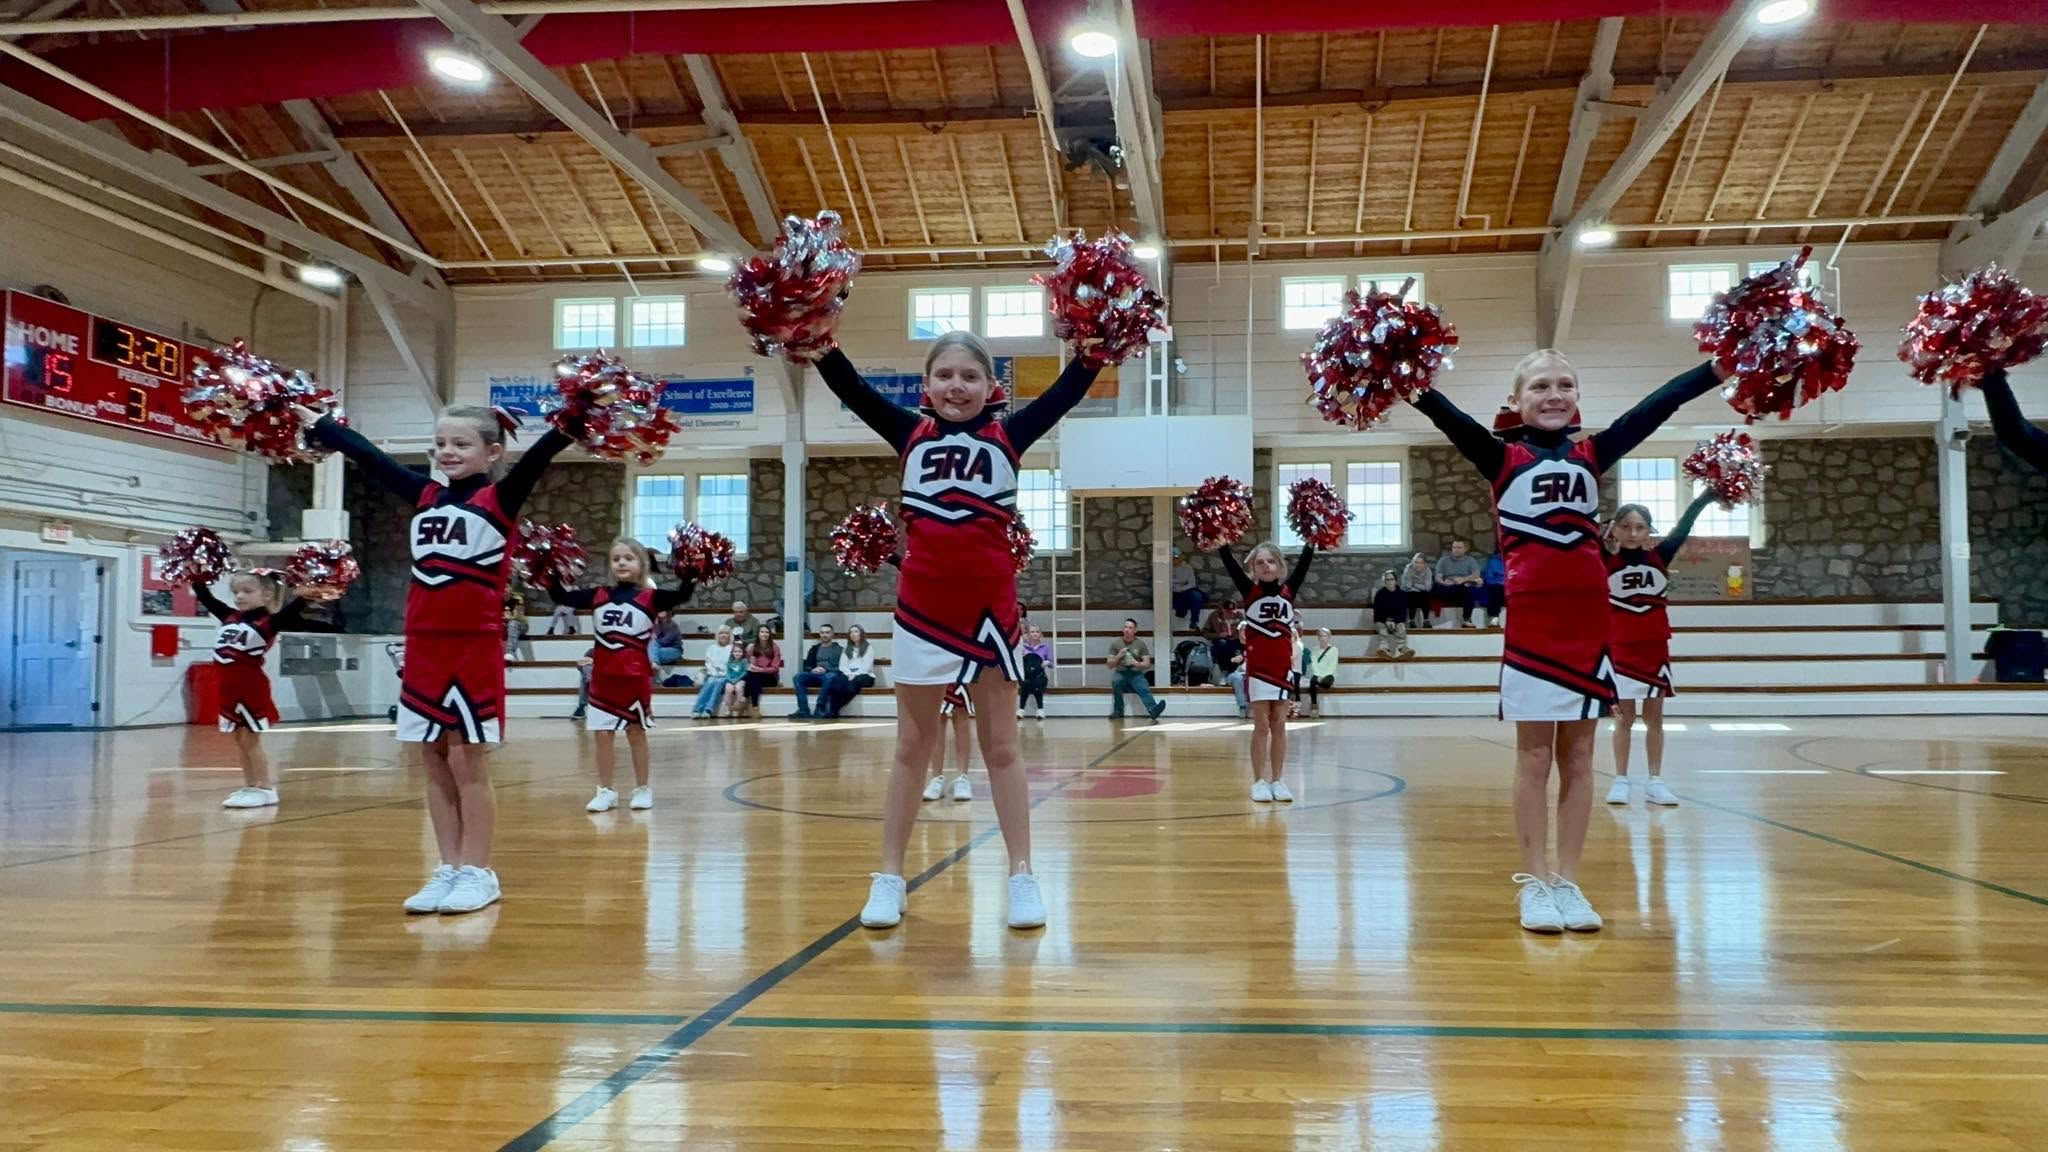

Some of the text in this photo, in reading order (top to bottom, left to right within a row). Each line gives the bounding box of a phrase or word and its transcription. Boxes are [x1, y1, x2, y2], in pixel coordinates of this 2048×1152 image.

[20, 321, 79, 355] HOME
[116, 327, 179, 377] 3:28
[45, 354, 72, 392] 15
[117, 367, 160, 389] PERIOD
[45, 395, 97, 416] BONUS
[129, 387, 147, 423] 3
[664, 388, 752, 400] School of Excellence
[919, 445, 993, 485] SRA
[1531, 472, 1588, 504] SRA
[416, 516, 468, 546] SRA
[1621, 571, 1655, 590] SRA
[601, 609, 633, 628] SRA
[1259, 602, 1289, 619] SRA
